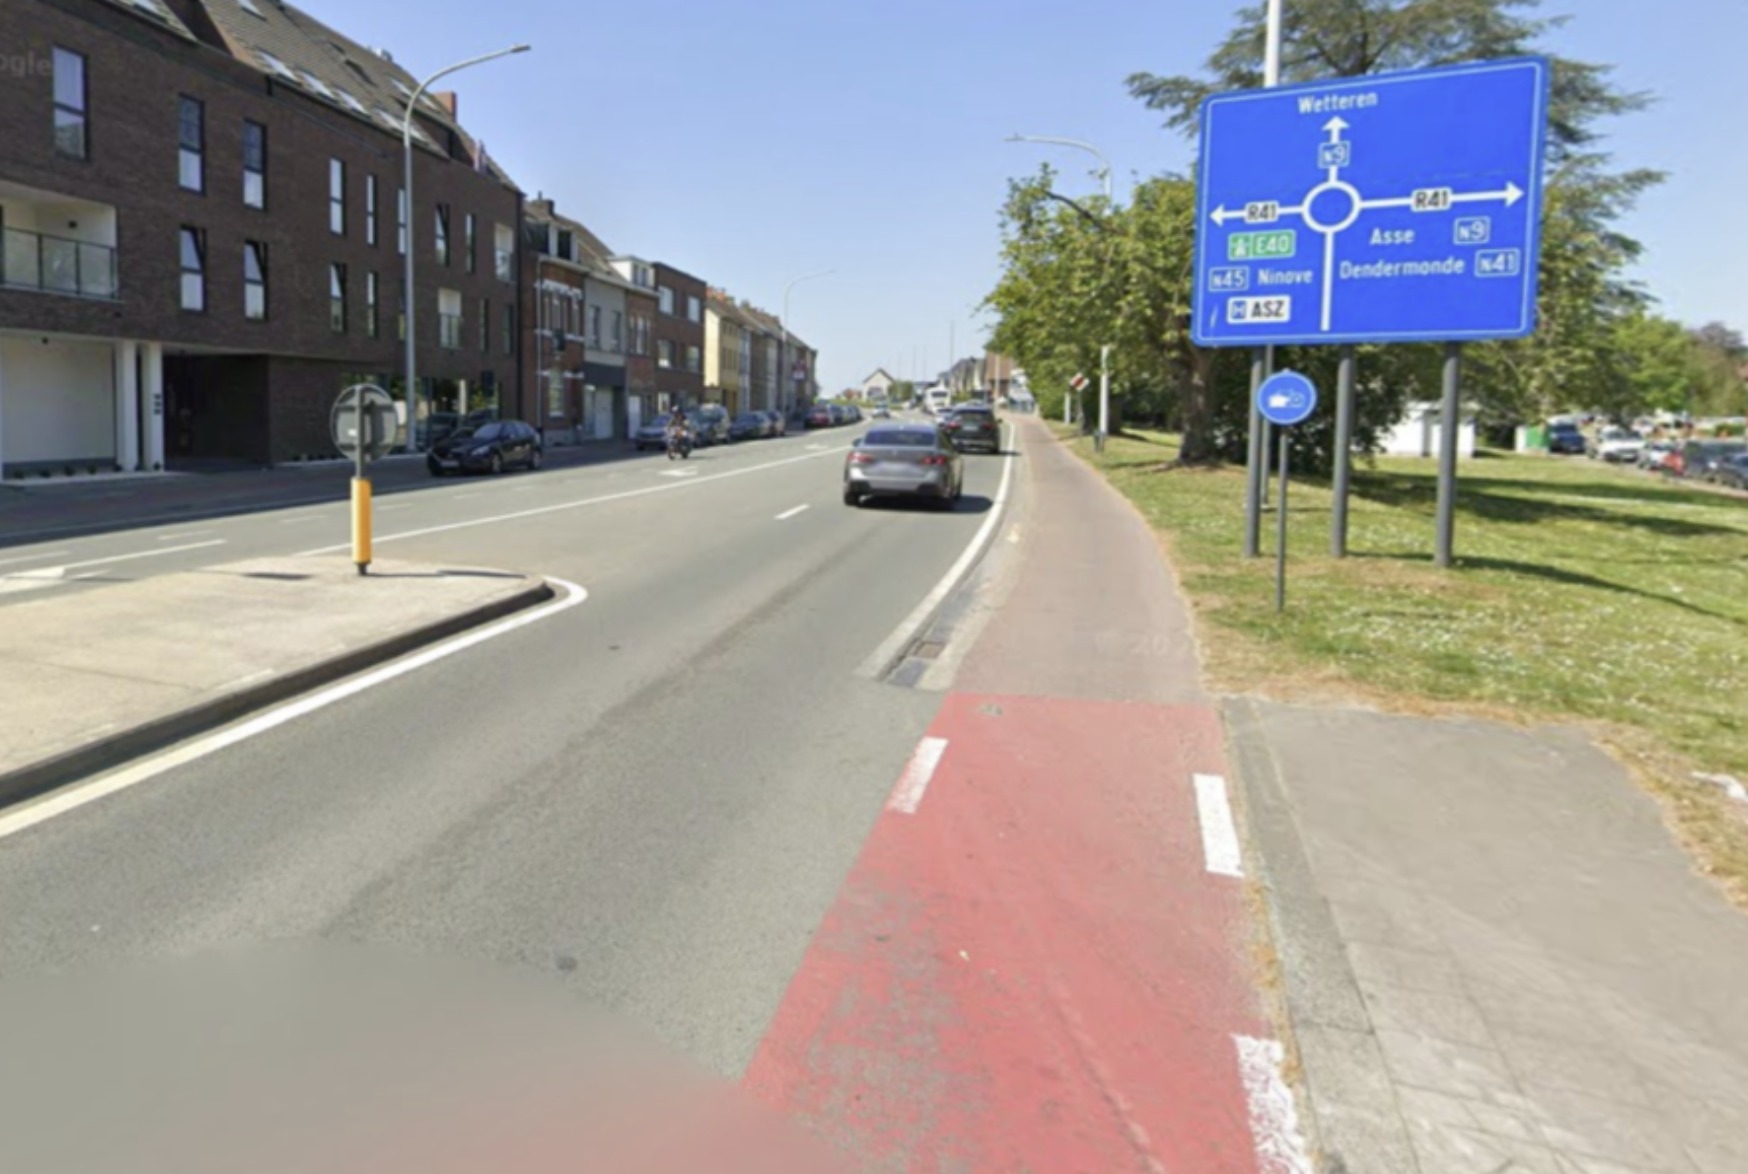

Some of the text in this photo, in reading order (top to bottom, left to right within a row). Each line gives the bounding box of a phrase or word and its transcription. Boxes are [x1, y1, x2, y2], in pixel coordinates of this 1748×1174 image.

[1298, 92, 1378, 114] Wetteren
[1323, 145, 1346, 163] N9
[1414, 190, 1448, 209] R41
[1248, 203, 1276, 220] R41
[1369, 227, 1415, 245] Asse
[1459, 220, 1486, 240] N9
[1256, 234, 1289, 254] E40
[1339, 256, 1465, 279] Dendermonde
[1479, 253, 1514, 271] N41
[1213, 270, 1244, 287] N45
[1258, 269, 1313, 285] Ninove
[1251, 301, 1285, 318] ASZ
